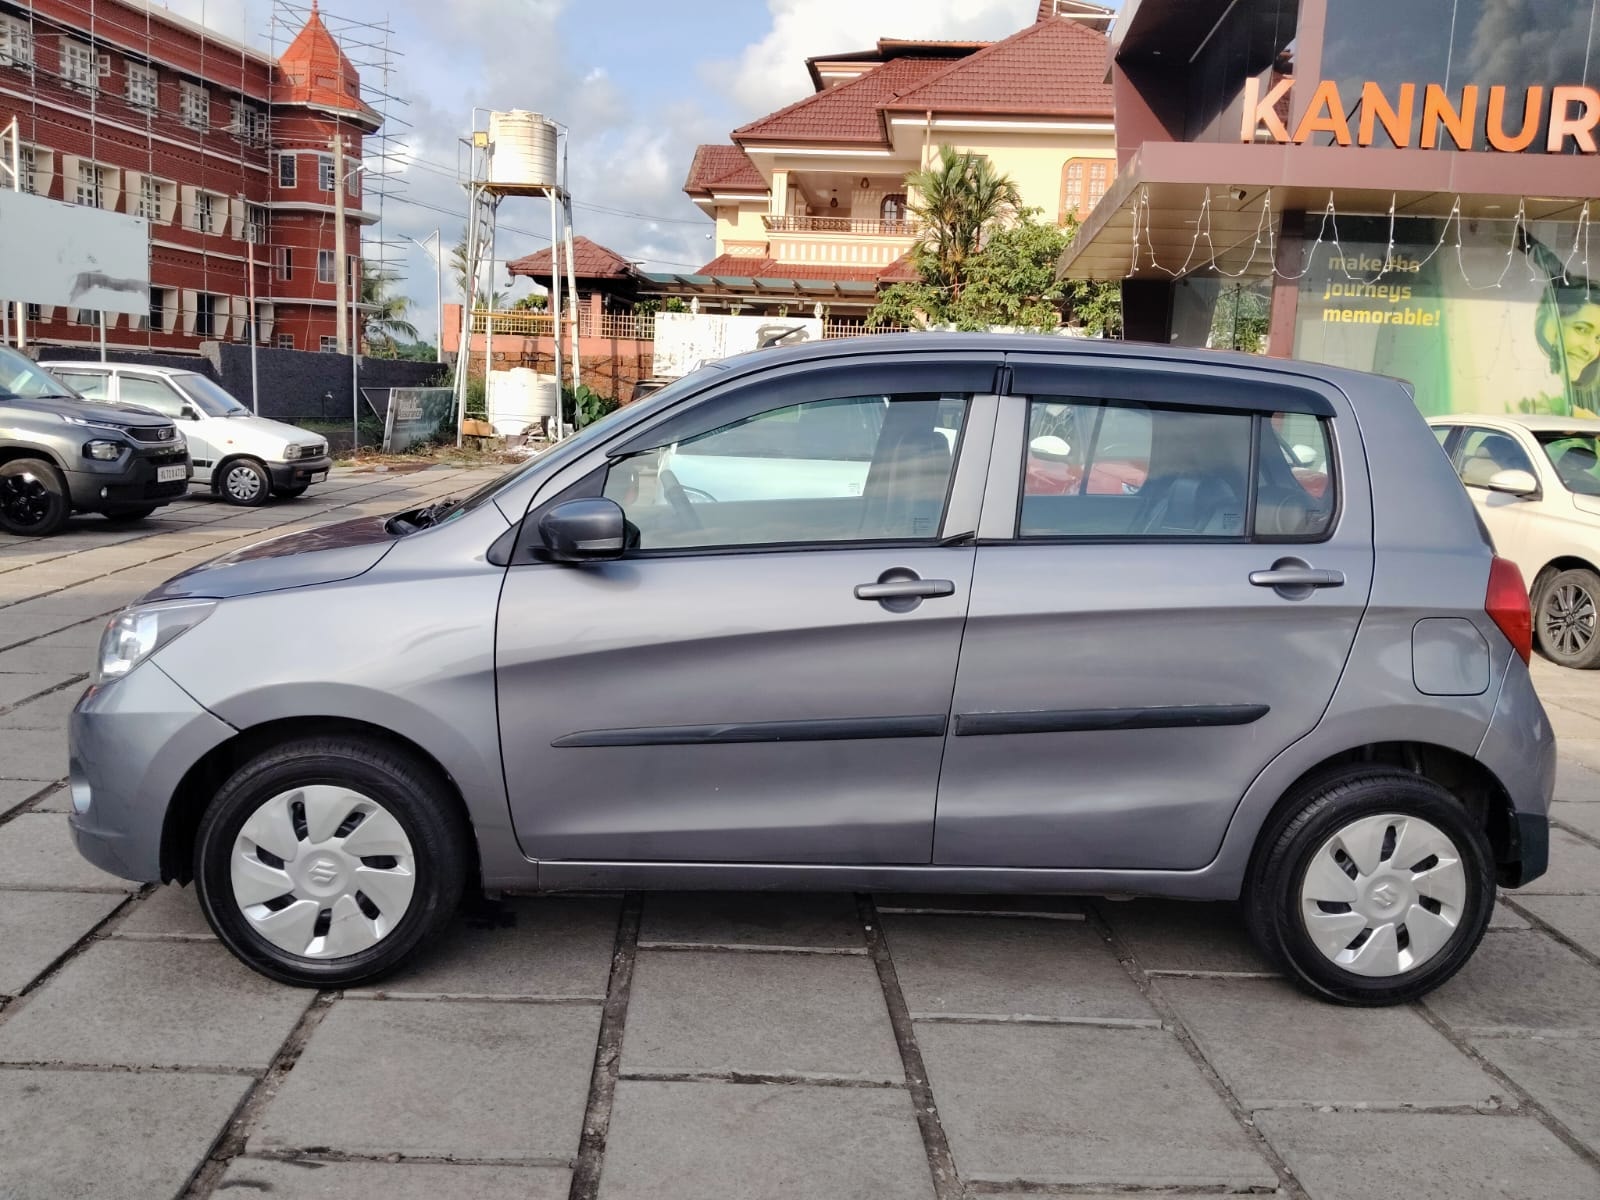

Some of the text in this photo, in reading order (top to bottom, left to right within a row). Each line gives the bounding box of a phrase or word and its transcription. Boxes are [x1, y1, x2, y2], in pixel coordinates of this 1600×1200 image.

[1240, 77, 1600, 153] KANNUR
[1328, 253, 1420, 273] make the
[1323, 278, 1412, 303] journeys
[1323, 307, 1441, 327] memorable!
